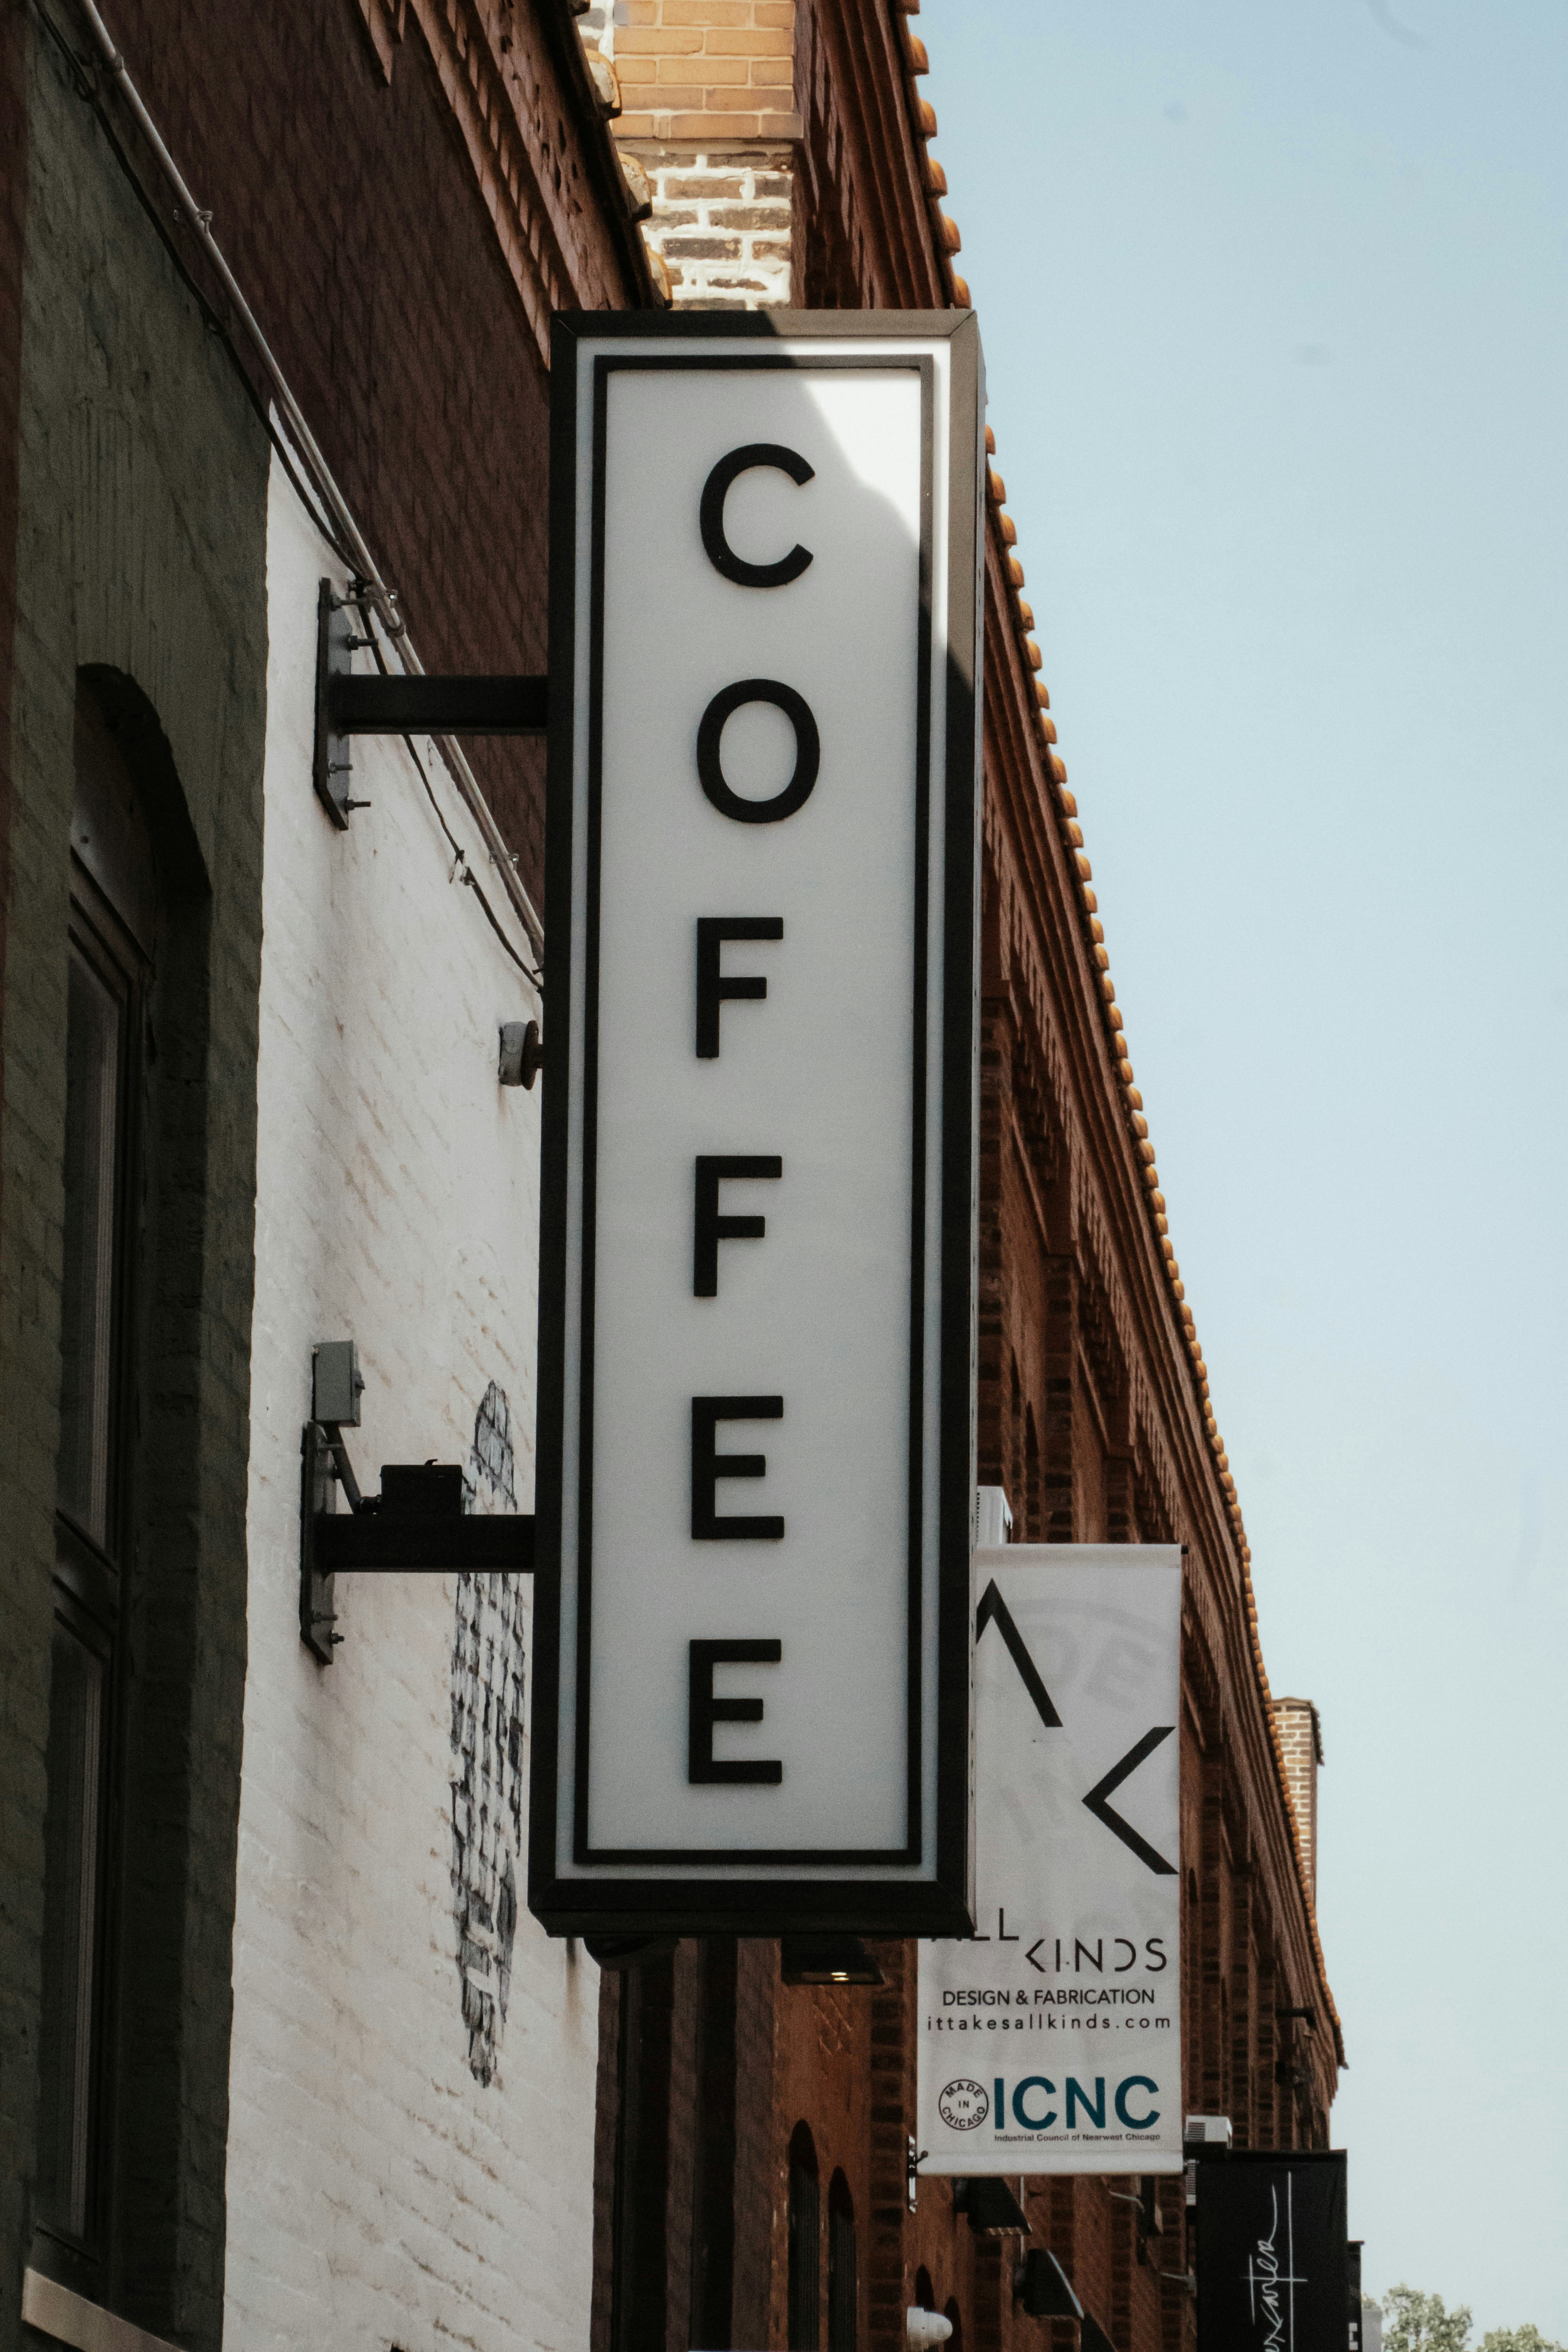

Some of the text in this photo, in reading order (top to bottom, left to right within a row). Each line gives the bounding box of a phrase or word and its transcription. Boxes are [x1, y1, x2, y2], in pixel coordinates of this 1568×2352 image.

[688, 444, 820, 1785] COFFEE
[943, 1989, 1154, 2006] DESIGN & FABRICATION
[927, 2013, 1170, 2031] ittakesallkinds.com
[945, 2083, 983, 2098] MADE
[958, 2100, 969, 2108] IN
[994, 2075, 1161, 2131] ICNC
[942, 2106, 985, 2127] CHICAGO
